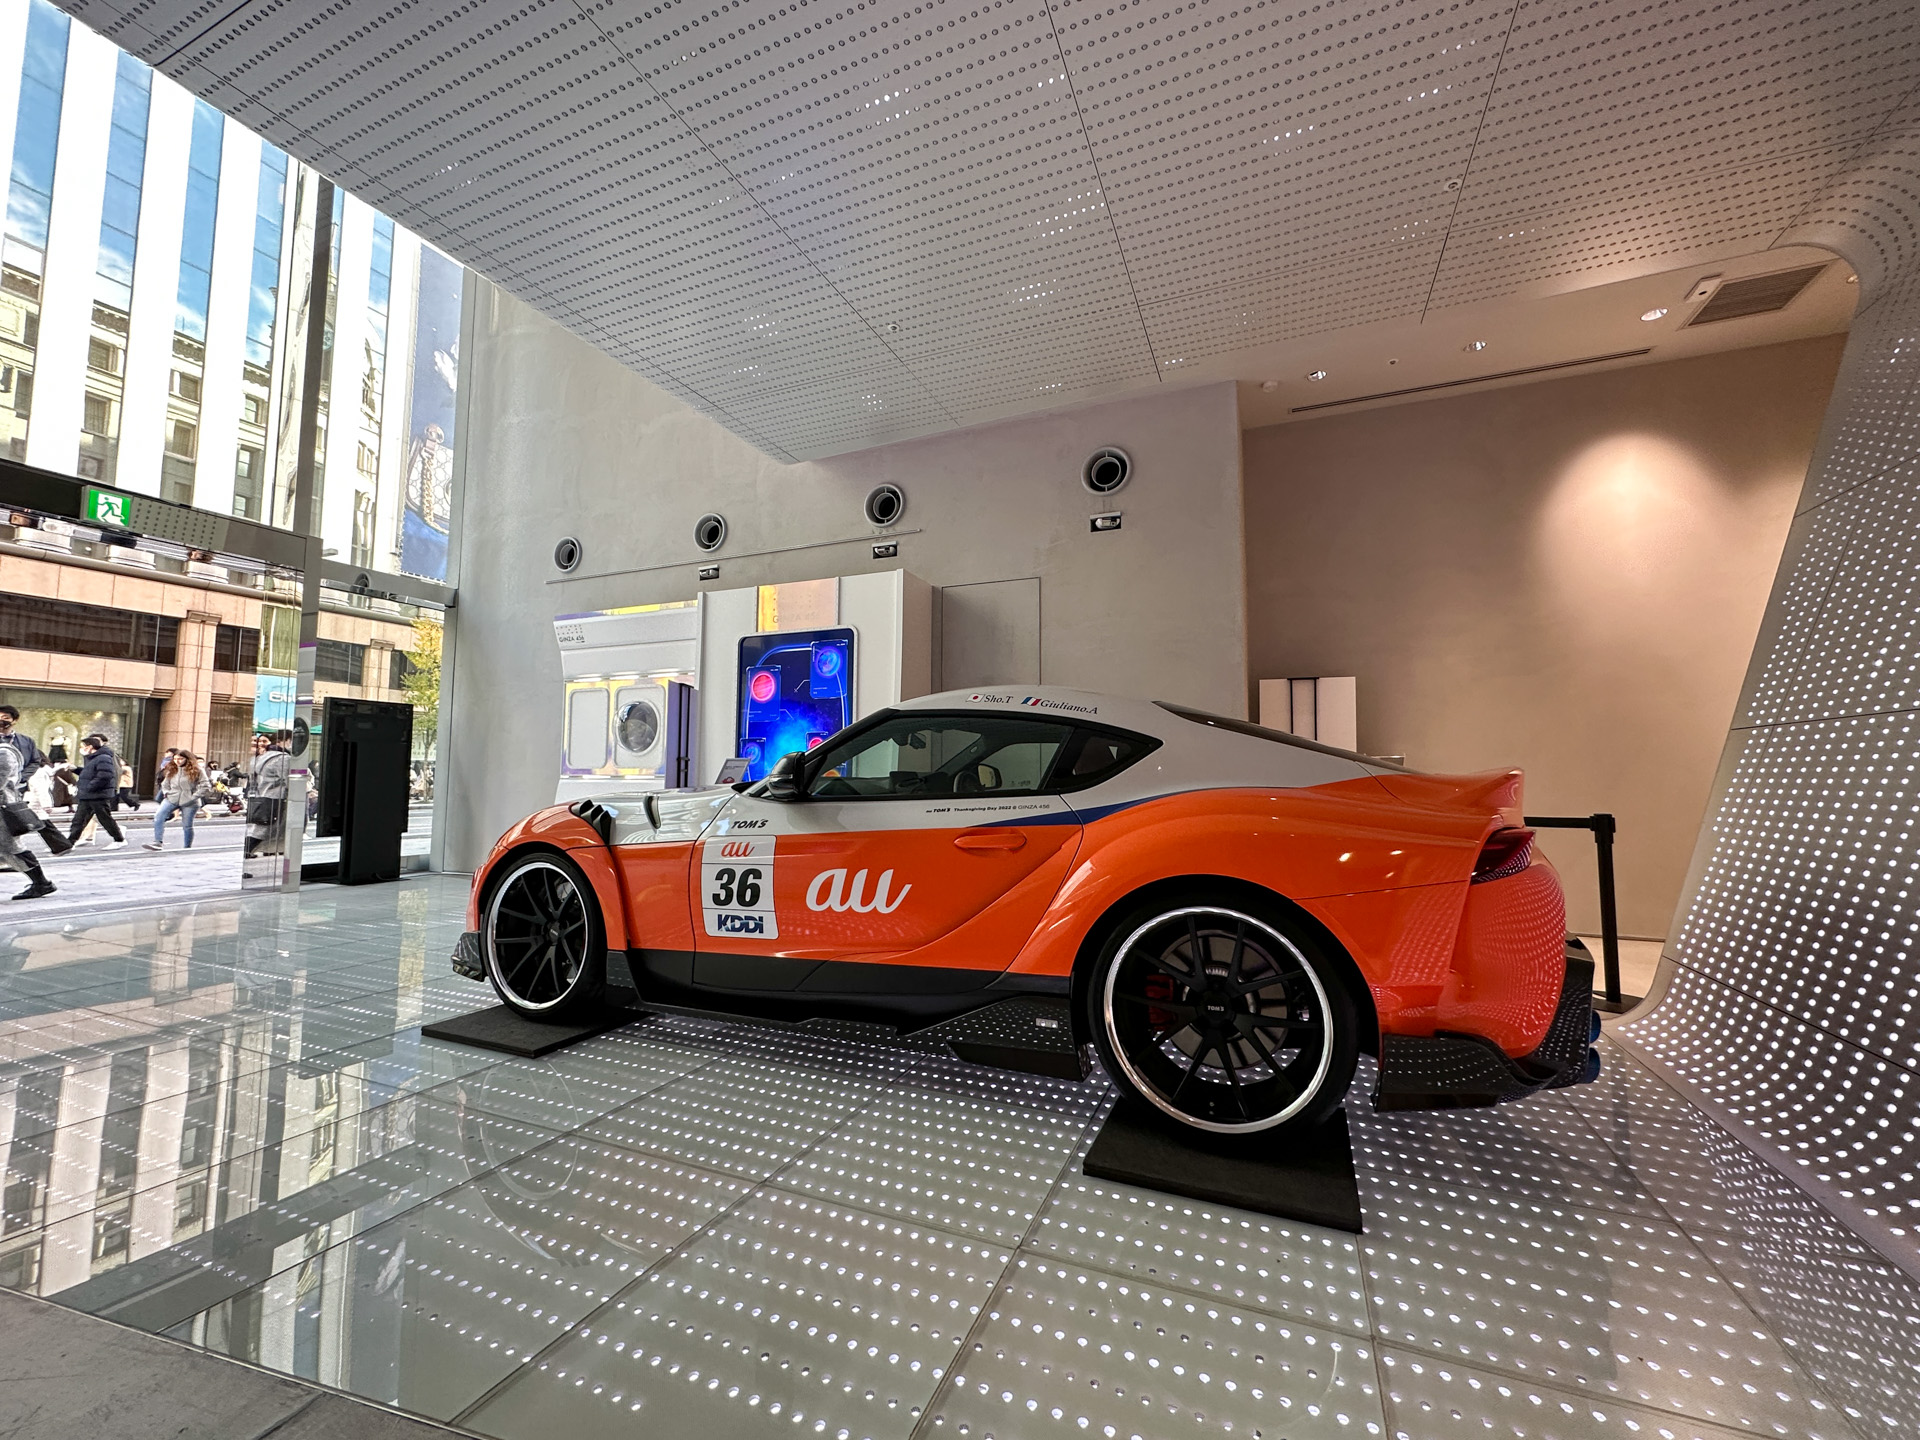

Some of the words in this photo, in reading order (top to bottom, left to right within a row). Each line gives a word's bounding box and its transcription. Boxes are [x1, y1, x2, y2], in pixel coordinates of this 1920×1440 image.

[984, 694, 1014, 704] Sho.T
[1040, 700, 1098, 715] Giuliano.A
[731, 819, 768, 829] TOM'S
[721, 841, 755, 857] au
[712, 868, 762, 907] 36
[806, 868, 913, 914] au
[717, 914, 764, 934] KDDI
